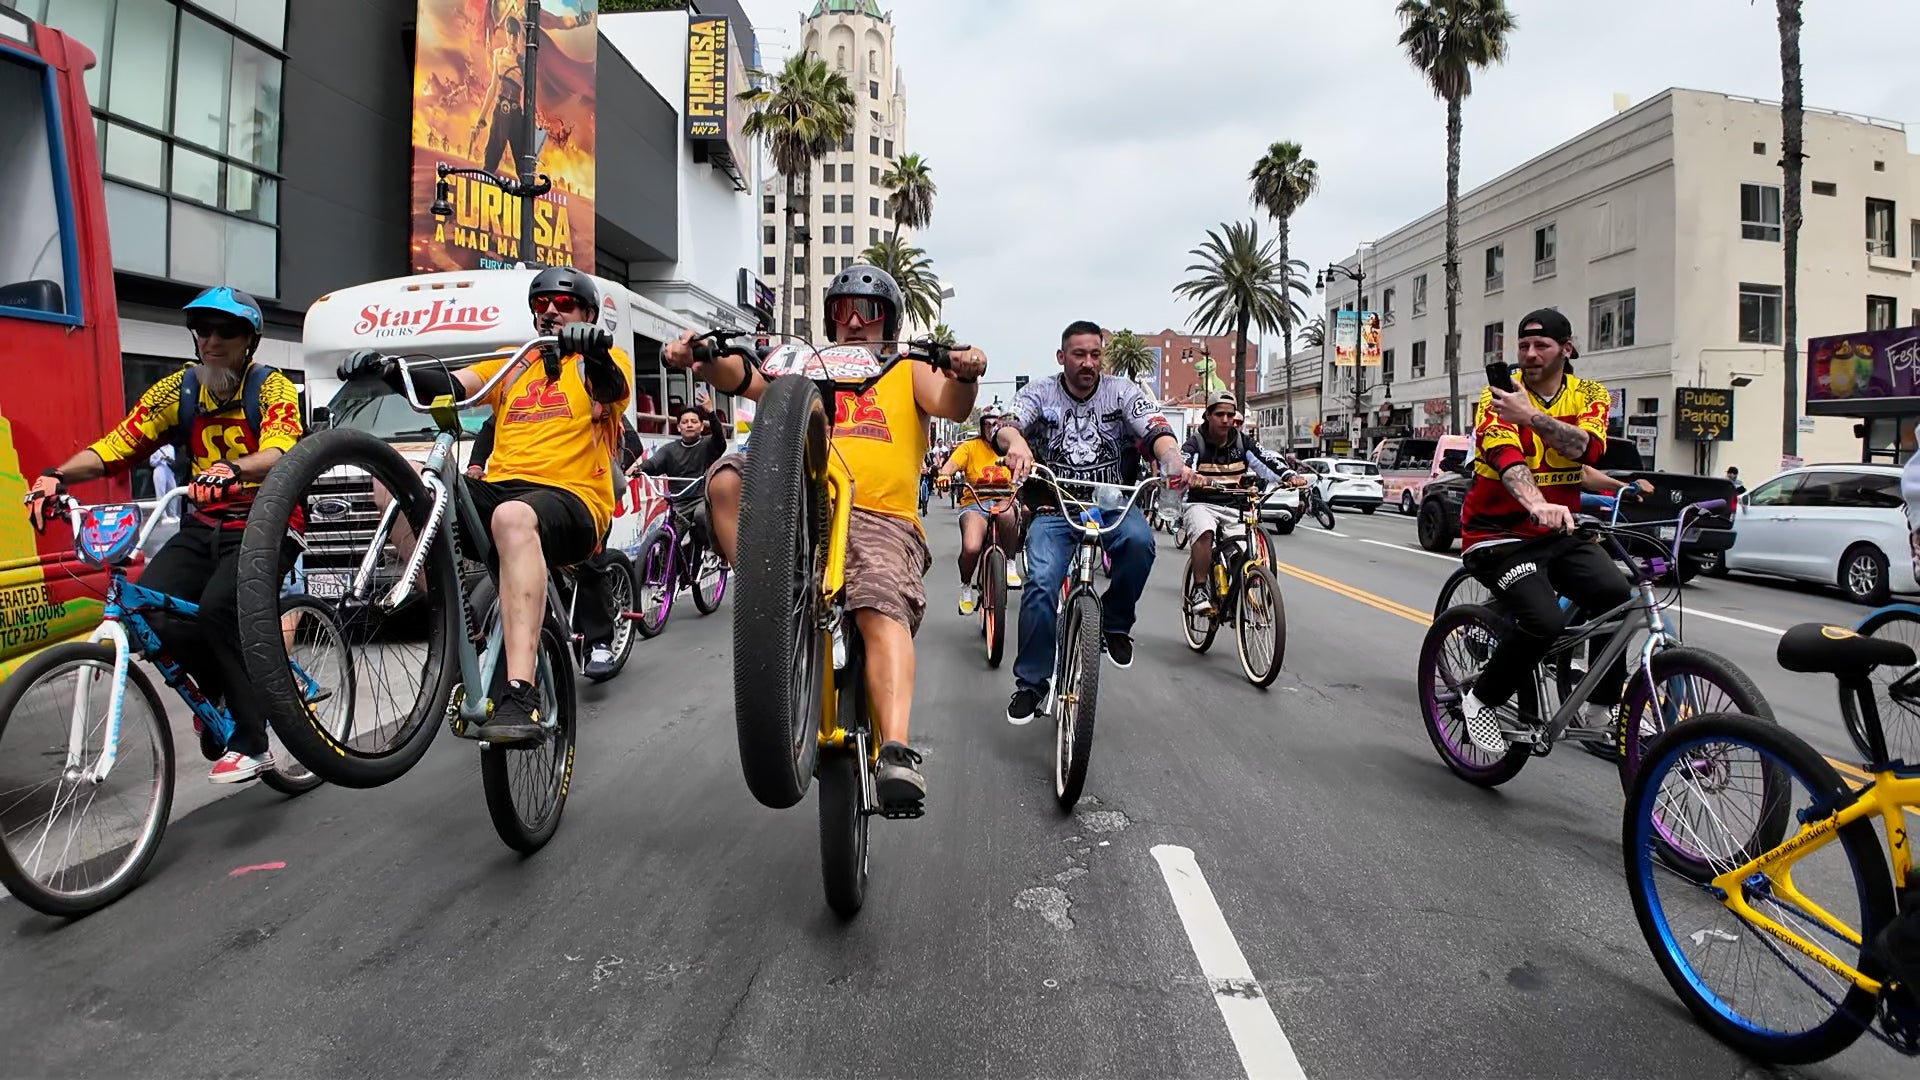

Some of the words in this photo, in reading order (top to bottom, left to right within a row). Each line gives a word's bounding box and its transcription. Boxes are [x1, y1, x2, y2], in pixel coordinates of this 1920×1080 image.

[715, 20, 726, 49] SAGA
[688, 20, 716, 117] FURIOSA
[714, 54, 725, 77] MAX
[714, 82, 725, 105] MAD
[714, 109, 725, 117] A
[434, 224, 446, 243] A
[454, 227, 489, 252] MAD
[497, 240, 519, 258] MA
[536, 247, 573, 267] SAGA
[354, 299, 501, 335] StarLine
[376, 327, 414, 338] TOURS
[1684, 391, 1726, 407] Public
[1680, 408, 1730, 428] Parking
[197, 474, 226, 484] FOX
[1497, 562, 1537, 590] HOODRICH
[31, 603, 66, 622] TOURS
[1, 628, 21, 649] TCP
[23, 622, 49, 643] 2275
